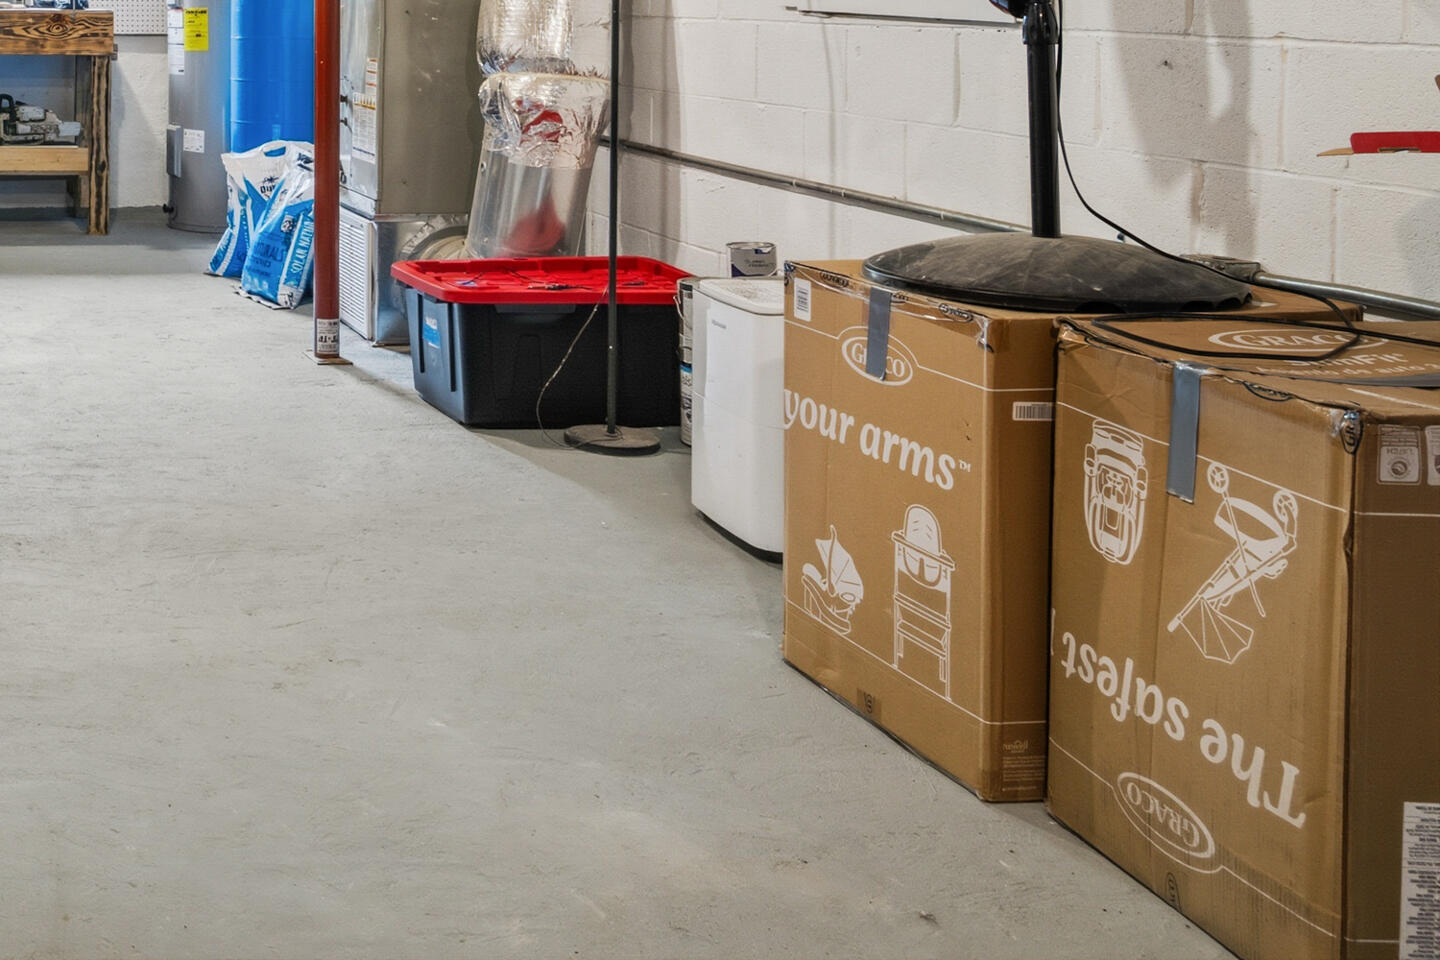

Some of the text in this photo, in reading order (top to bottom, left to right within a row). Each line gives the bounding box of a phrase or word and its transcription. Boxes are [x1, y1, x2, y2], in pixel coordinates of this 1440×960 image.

[851, 342, 906, 377] GCO
[784, 389, 855, 445] your
[1061, 632, 1307, 829] The safest
[1126, 782, 1201, 848] GRACO
